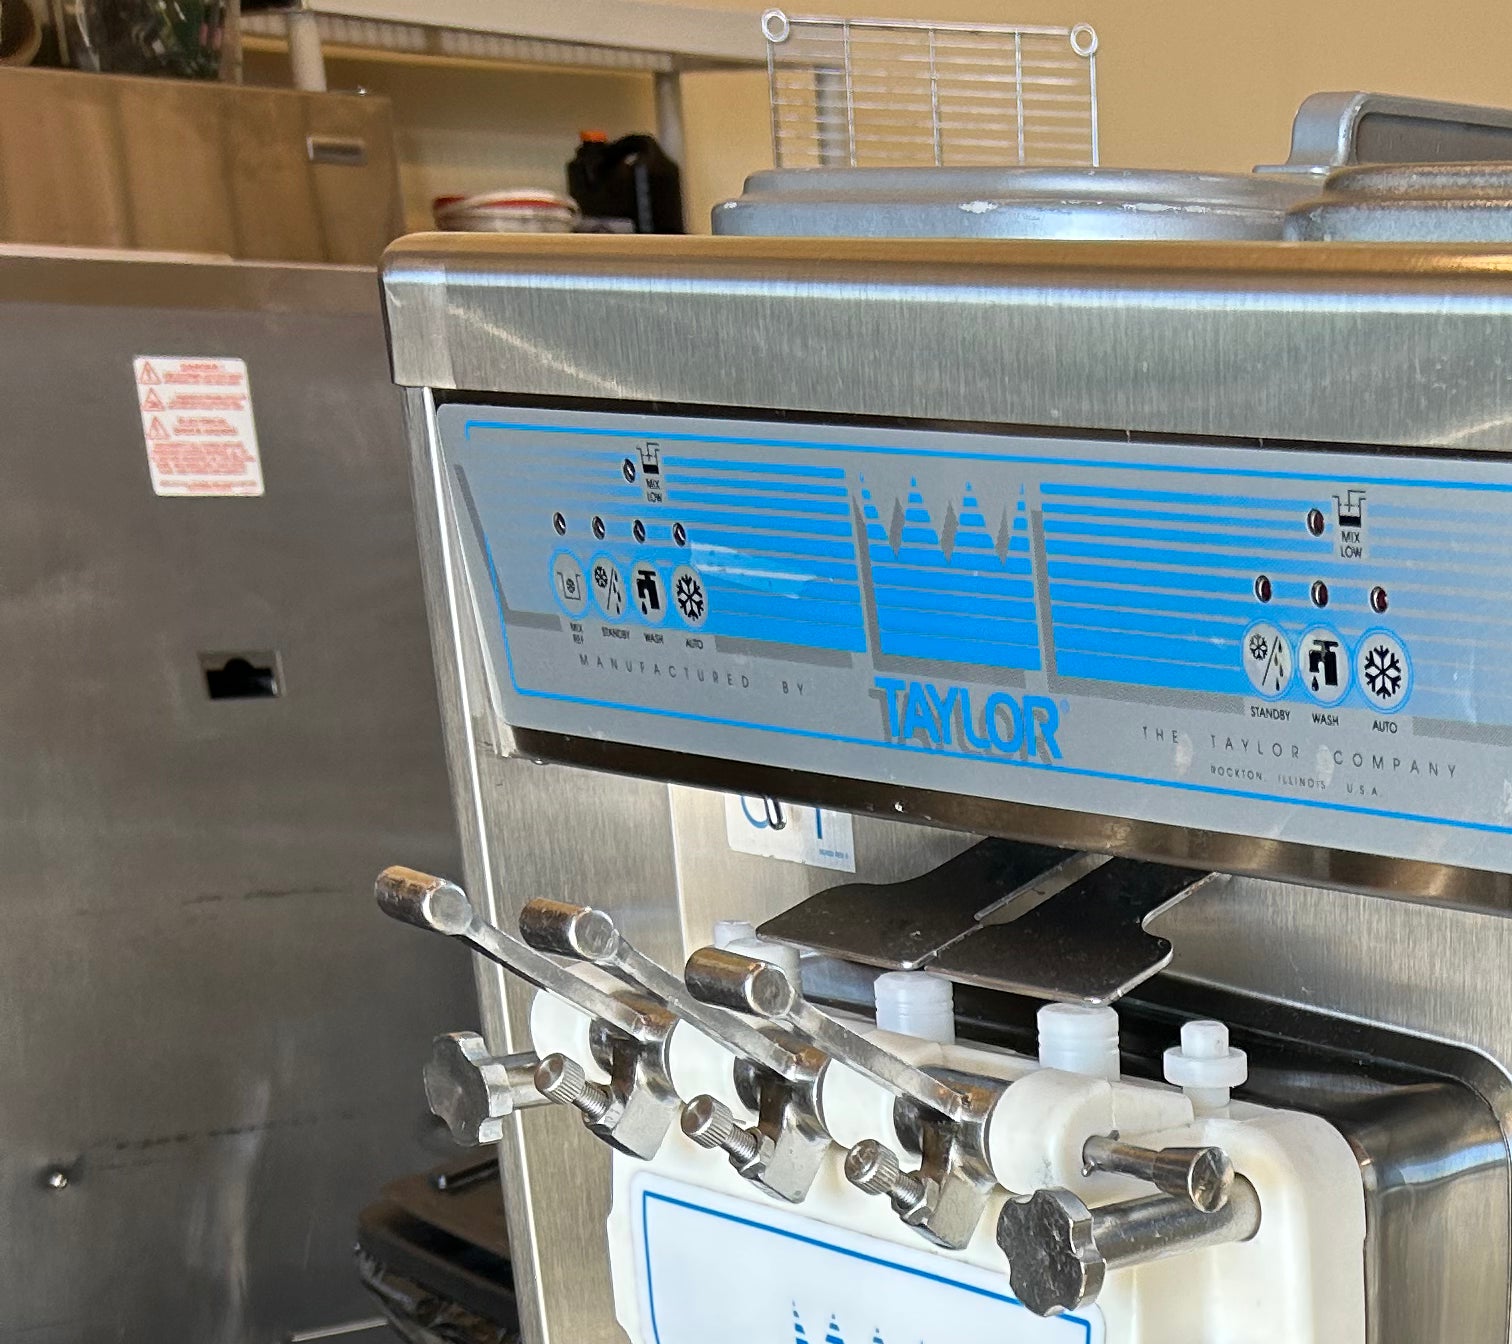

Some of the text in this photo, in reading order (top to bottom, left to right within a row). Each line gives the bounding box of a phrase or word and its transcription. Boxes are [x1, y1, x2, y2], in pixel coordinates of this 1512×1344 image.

[1341, 530, 1361, 544] MIX
[1340, 545, 1363, 559] LOW
[579, 653, 804, 696] MANUFACTURED BY
[868, 675, 1064, 766] TAYLOR
[1250, 705, 1291, 722] STANDBY
[1311, 712, 1340, 727] WASH
[1371, 719, 1398, 734] AUTO
[1143, 725, 1457, 779] THE TAYLOR COMPANY
